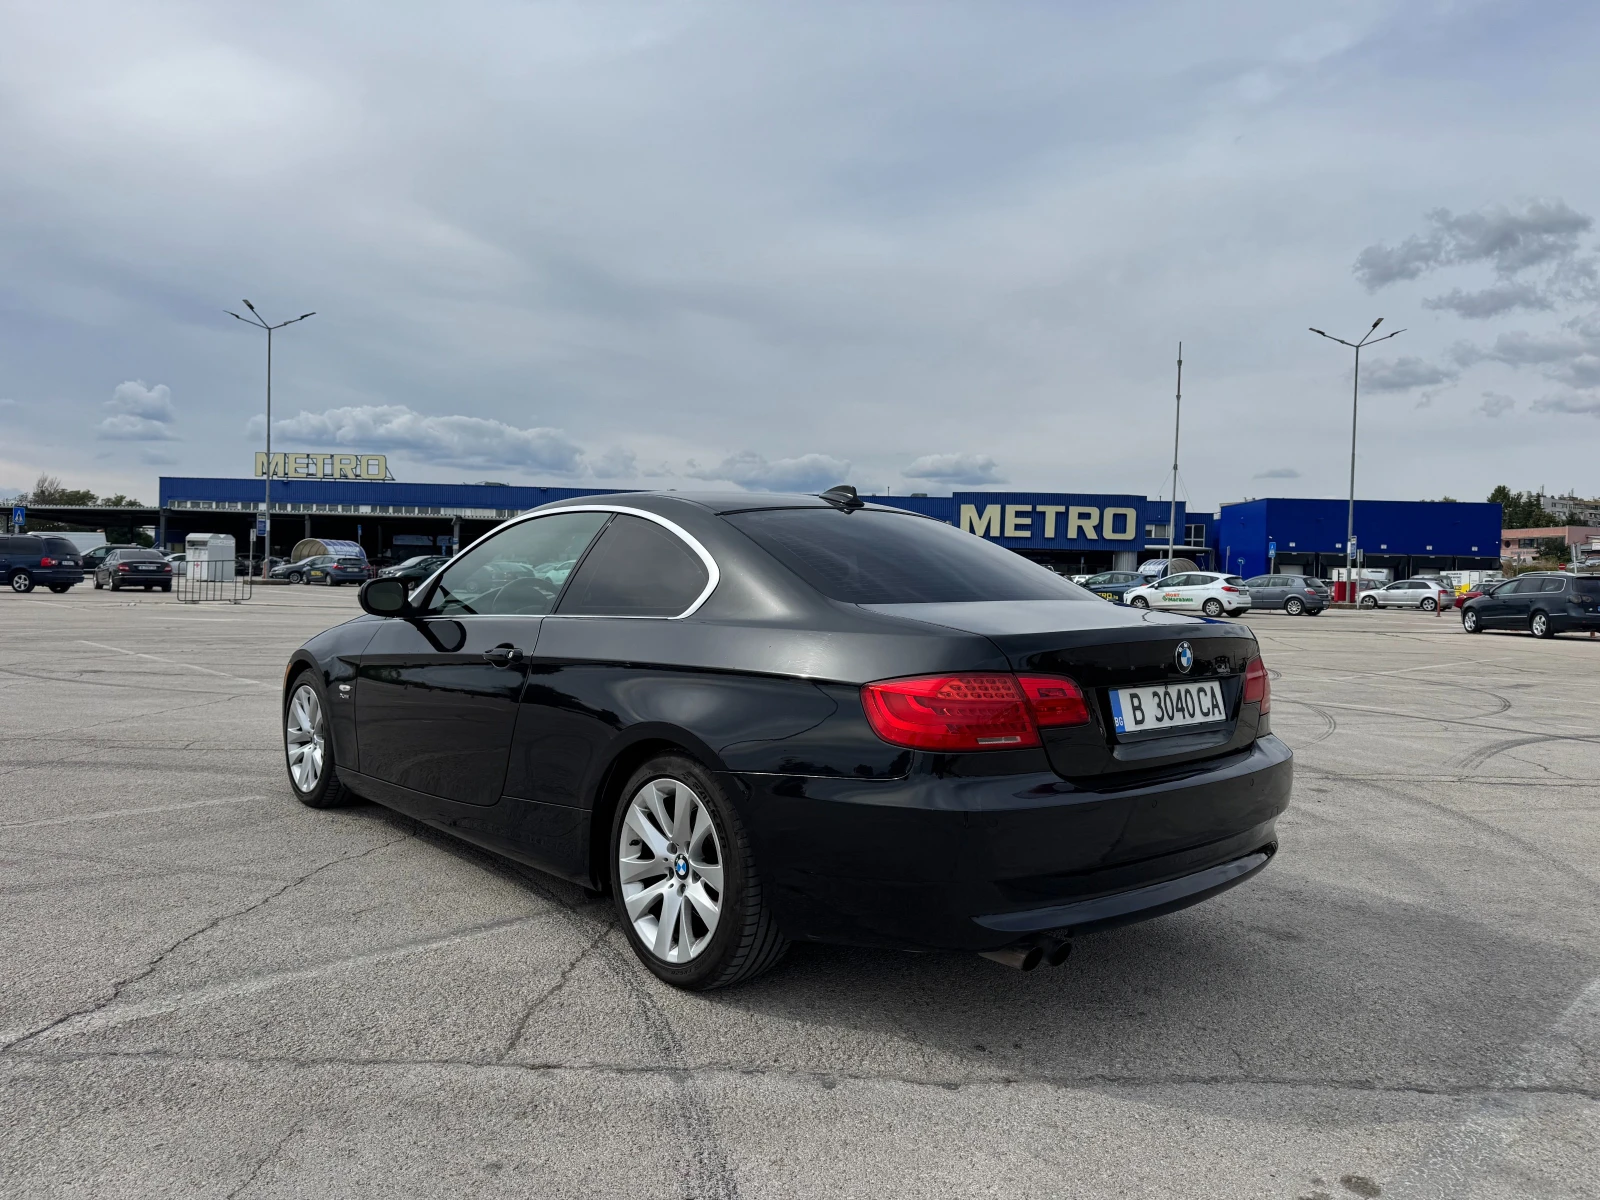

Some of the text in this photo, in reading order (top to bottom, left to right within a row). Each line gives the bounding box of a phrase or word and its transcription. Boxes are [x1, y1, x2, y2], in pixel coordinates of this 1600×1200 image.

[255, 452, 387, 480] METRO
[960, 504, 1137, 540] METRO
[1114, 717, 1124, 727] BG
[1129, 692, 1145, 725] B
